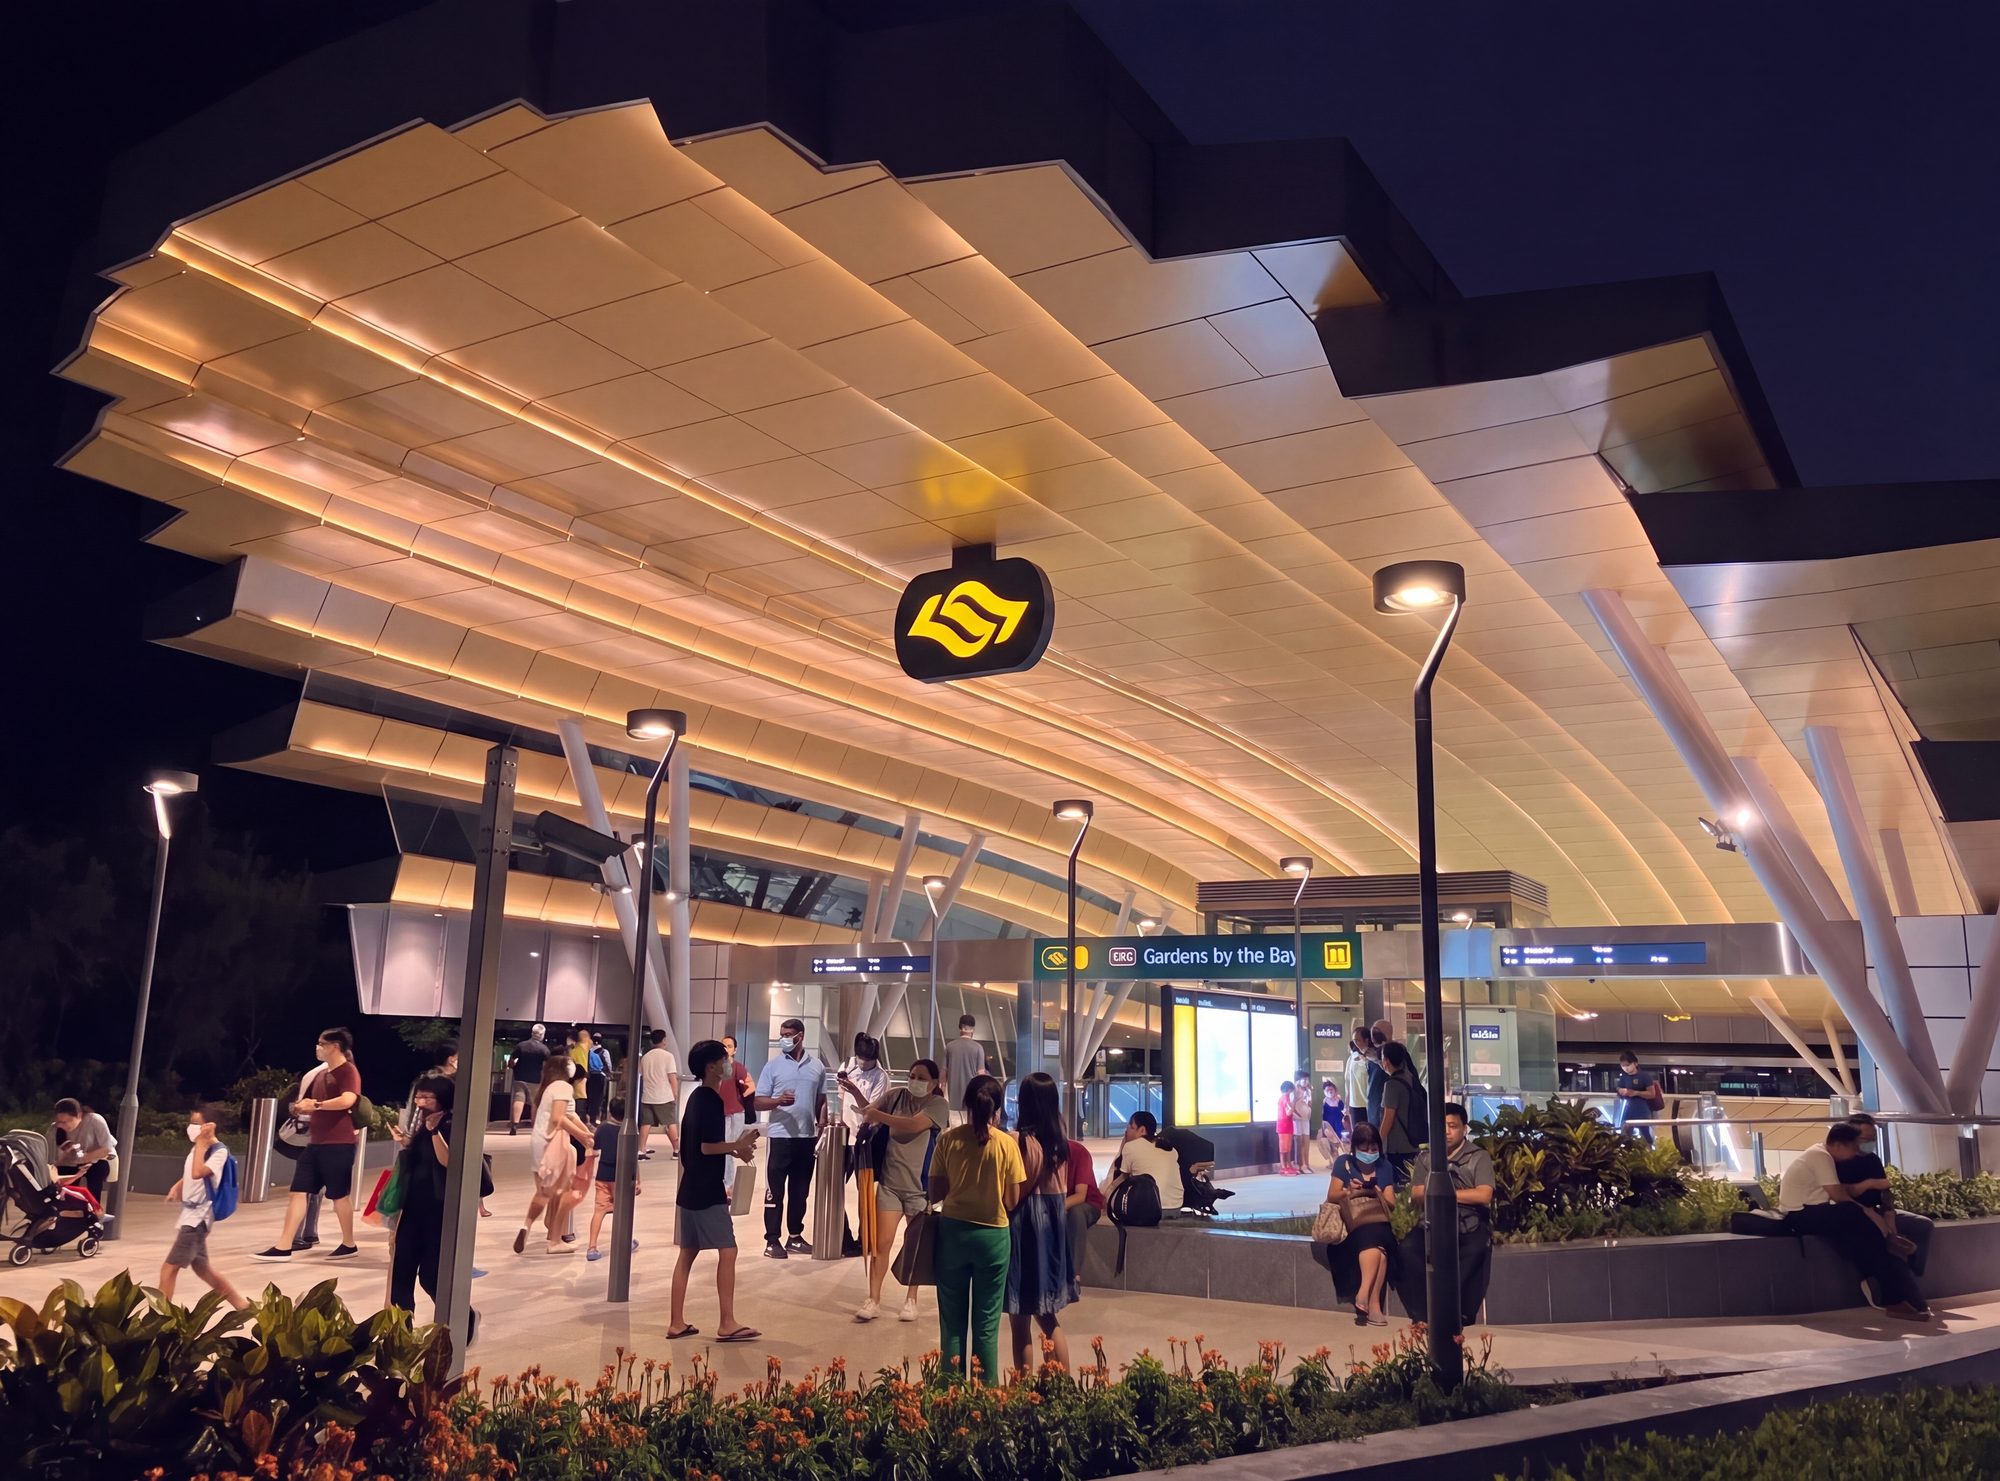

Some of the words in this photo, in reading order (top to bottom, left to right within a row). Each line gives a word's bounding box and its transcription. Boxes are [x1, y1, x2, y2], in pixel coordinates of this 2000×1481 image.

[1143, 947, 1209, 965] Gardens
[1213, 946, 1233, 968] by
[1237, 946, 1265, 964] the
[1269, 946, 1297, 968] Bay
